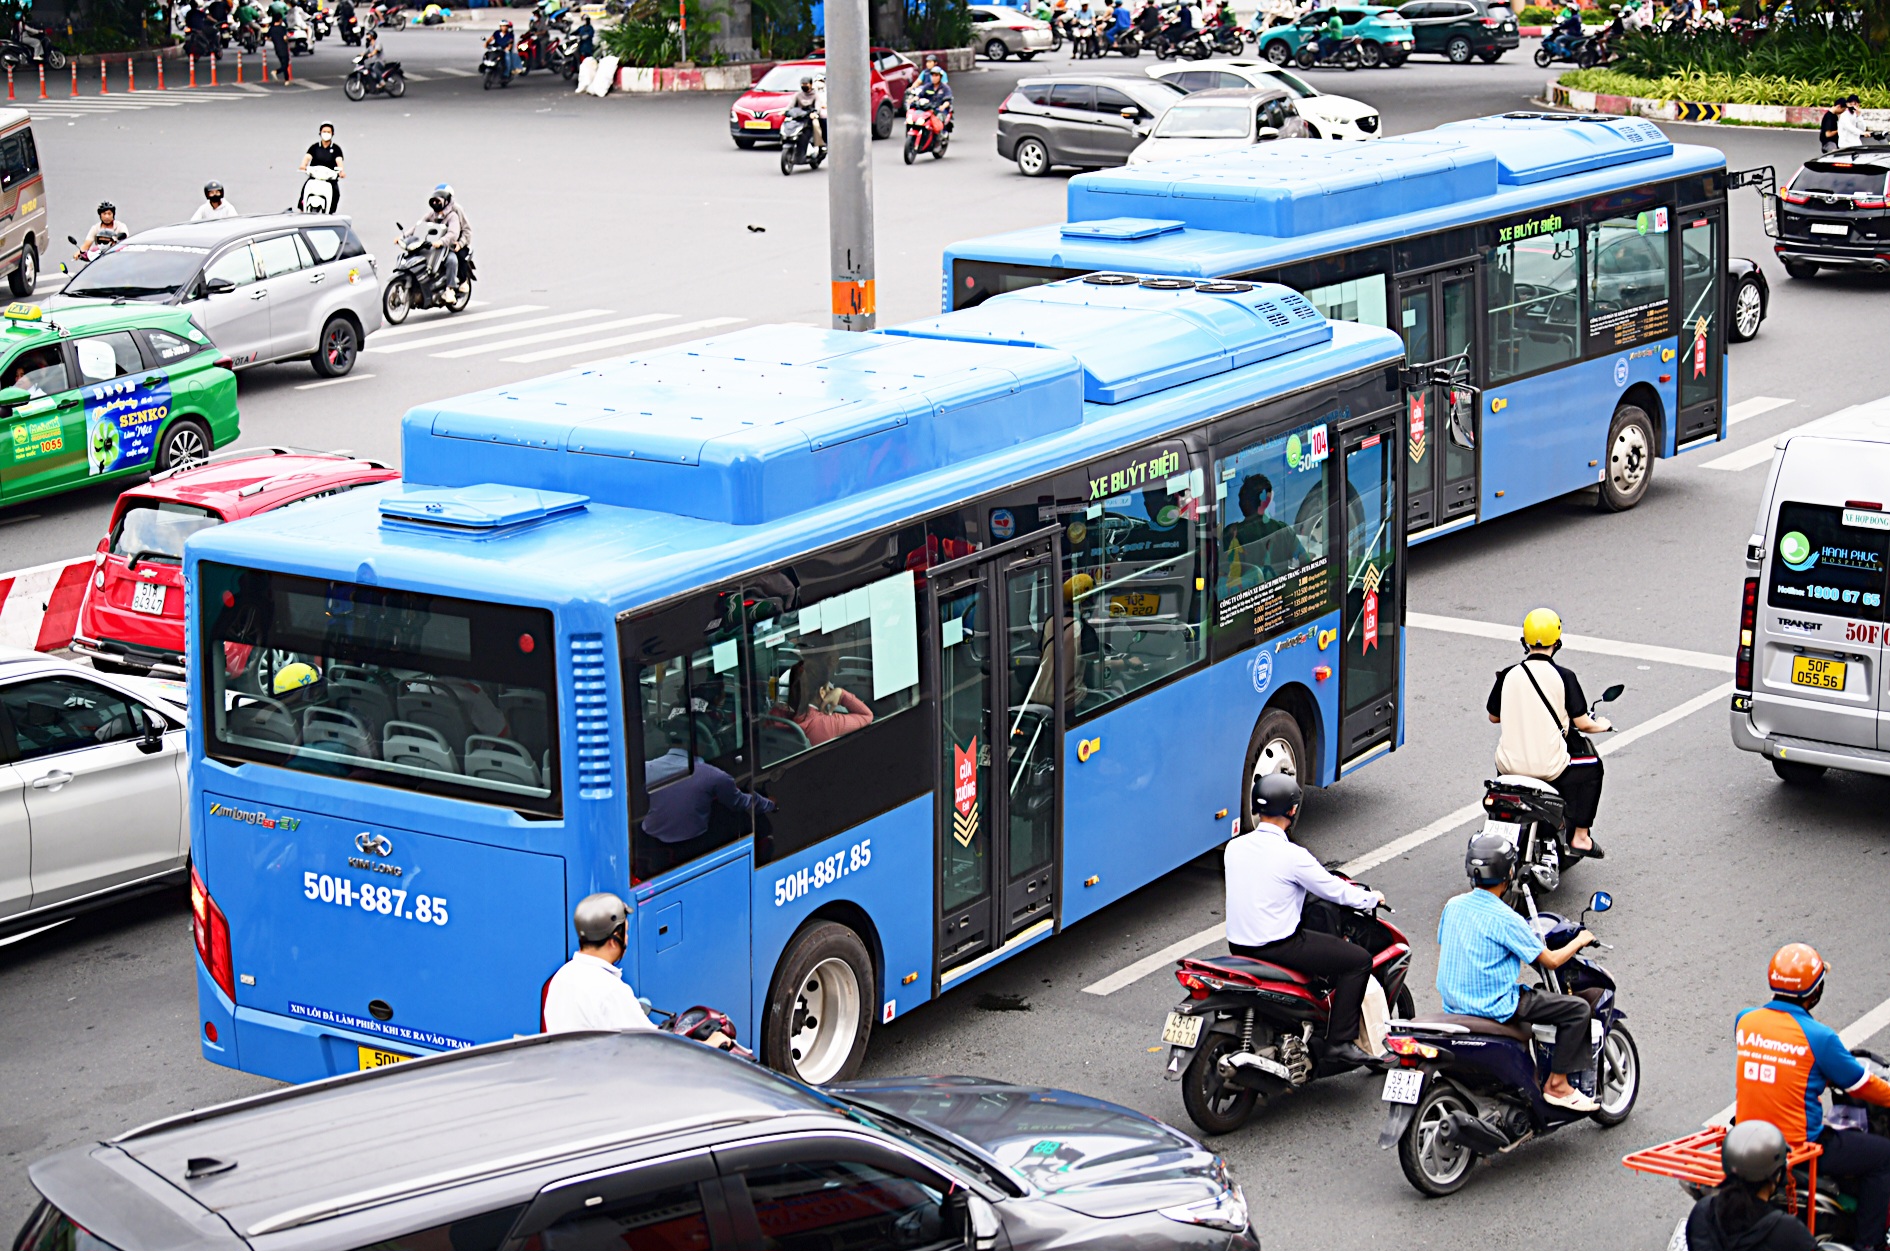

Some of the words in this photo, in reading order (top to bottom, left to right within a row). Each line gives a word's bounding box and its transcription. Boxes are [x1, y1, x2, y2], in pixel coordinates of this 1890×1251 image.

[1499, 225, 1512, 242] XE
[1513, 217, 1540, 238] BUÝT
[1540, 213, 1562, 234] ĐIỆN
[1656, 212, 1667, 229] 104
[119, 405, 168, 429] SENKO
[41, 437, 63, 453] 1055
[1311, 431, 1327, 456] 104
[1089, 474, 1108, 501] XE
[1110, 459, 1147, 494] BUÝT
[1149, 449, 1179, 480] ĐIỆN
[1845, 513, 1854, 522] XE
[1821, 556, 1877, 568] HOSPITAL
[1806, 584, 1840, 602] 1900
[1841, 589, 1860, 604] 67
[1862, 592, 1881, 607] 65
[1777, 617, 1823, 631] TRANSIT
[1845, 622, 1880, 644] 50F
[1807, 659, 1830, 673] 50F
[298, 673, 313, 687] be
[1797, 671, 1838, 688] 055.56
[959, 757, 973, 781] CỬA
[955, 778, 976, 804] XUỐNG
[348, 856, 370, 871] KIM
[371, 861, 403, 877] LONG
[774, 838, 872, 907] 50H-887.85
[304, 871, 449, 926] 50H-887.85
[291, 1003, 305, 1014] XIN
[322, 1010, 335, 1022] ĐÃ
[336, 1013, 355, 1027] LÀM
[382, 1025, 399, 1036] KHI
[400, 1029, 412, 1039] XE
[413, 1031, 425, 1043] RA
[425, 1033, 445, 1047] VÀO
[1172, 1014, 1197, 1031] 43-C1
[1163, 1028, 1196, 1046] 219.78
[1746, 1032, 1806, 1057] Ahamove
[1392, 1071, 1416, 1087] 59-X1
